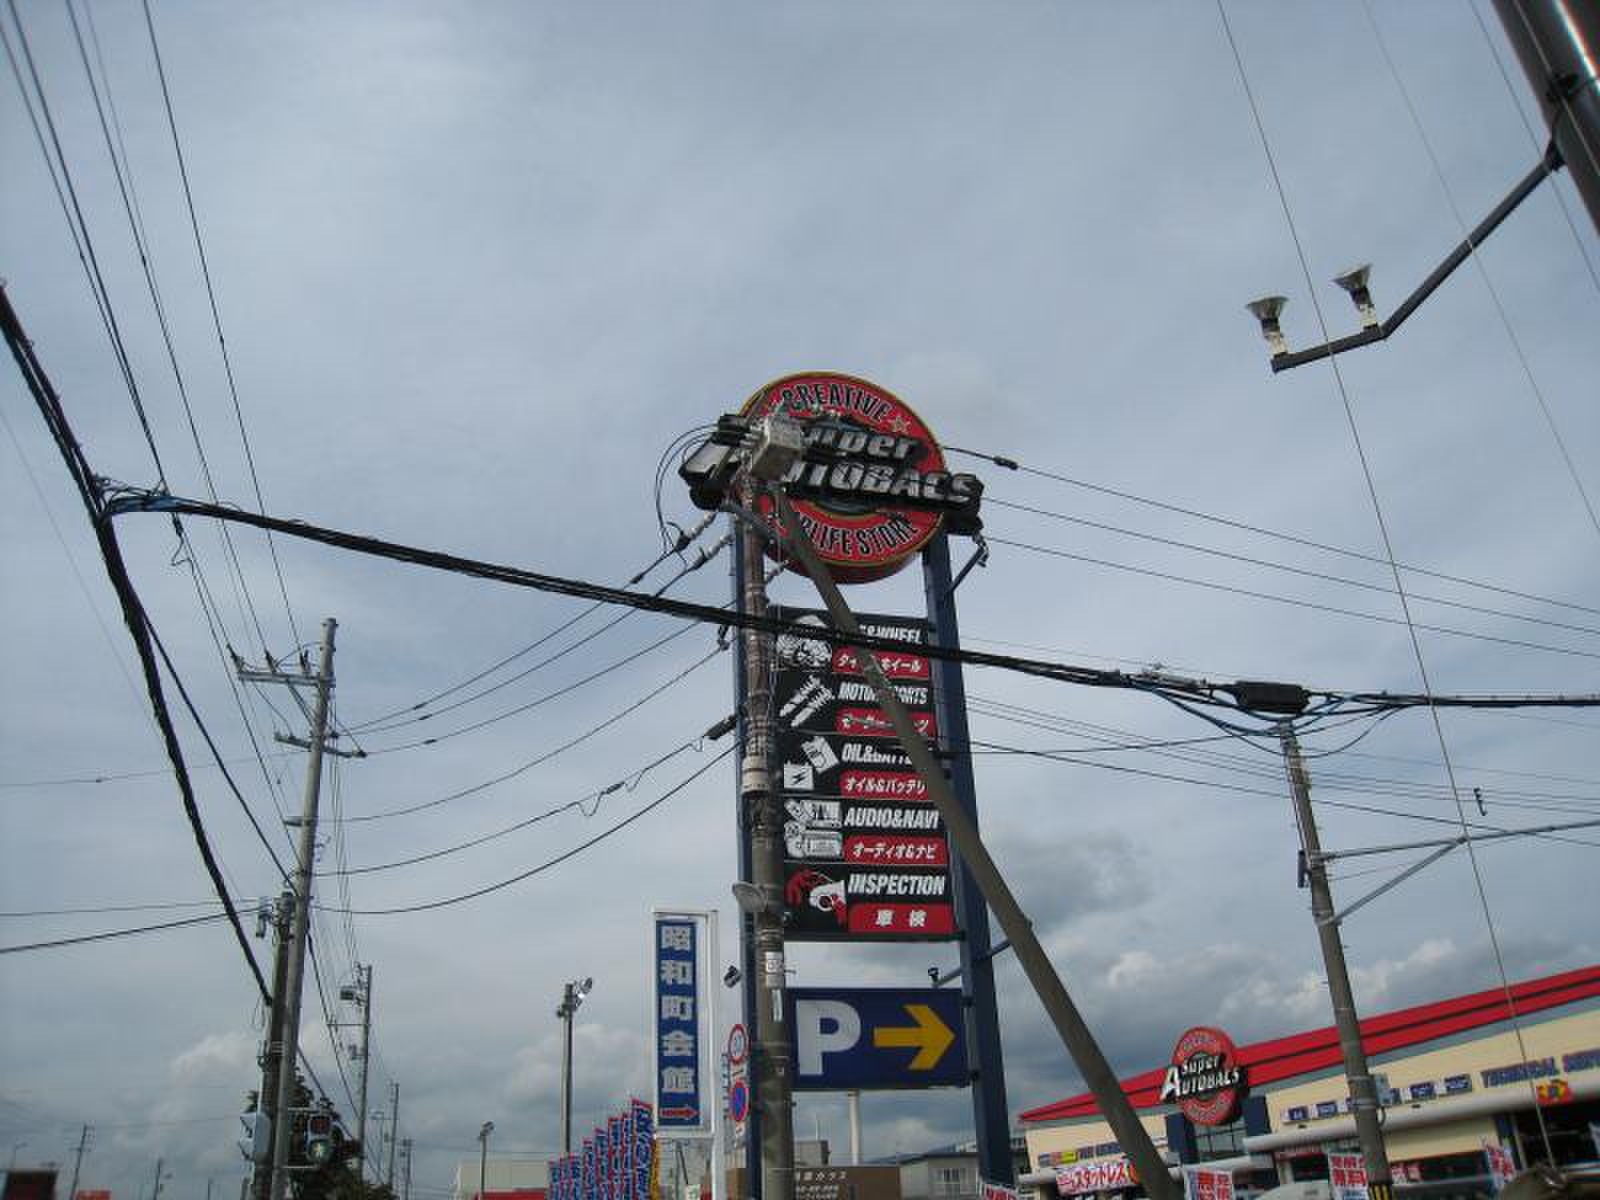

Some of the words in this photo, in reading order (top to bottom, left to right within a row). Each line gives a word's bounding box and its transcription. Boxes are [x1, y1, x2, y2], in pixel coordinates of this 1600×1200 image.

[844, 806, 939, 829] AUDIO&NAVI
[847, 873, 946, 895] INSPECTION
[796, 999, 861, 1076] P
